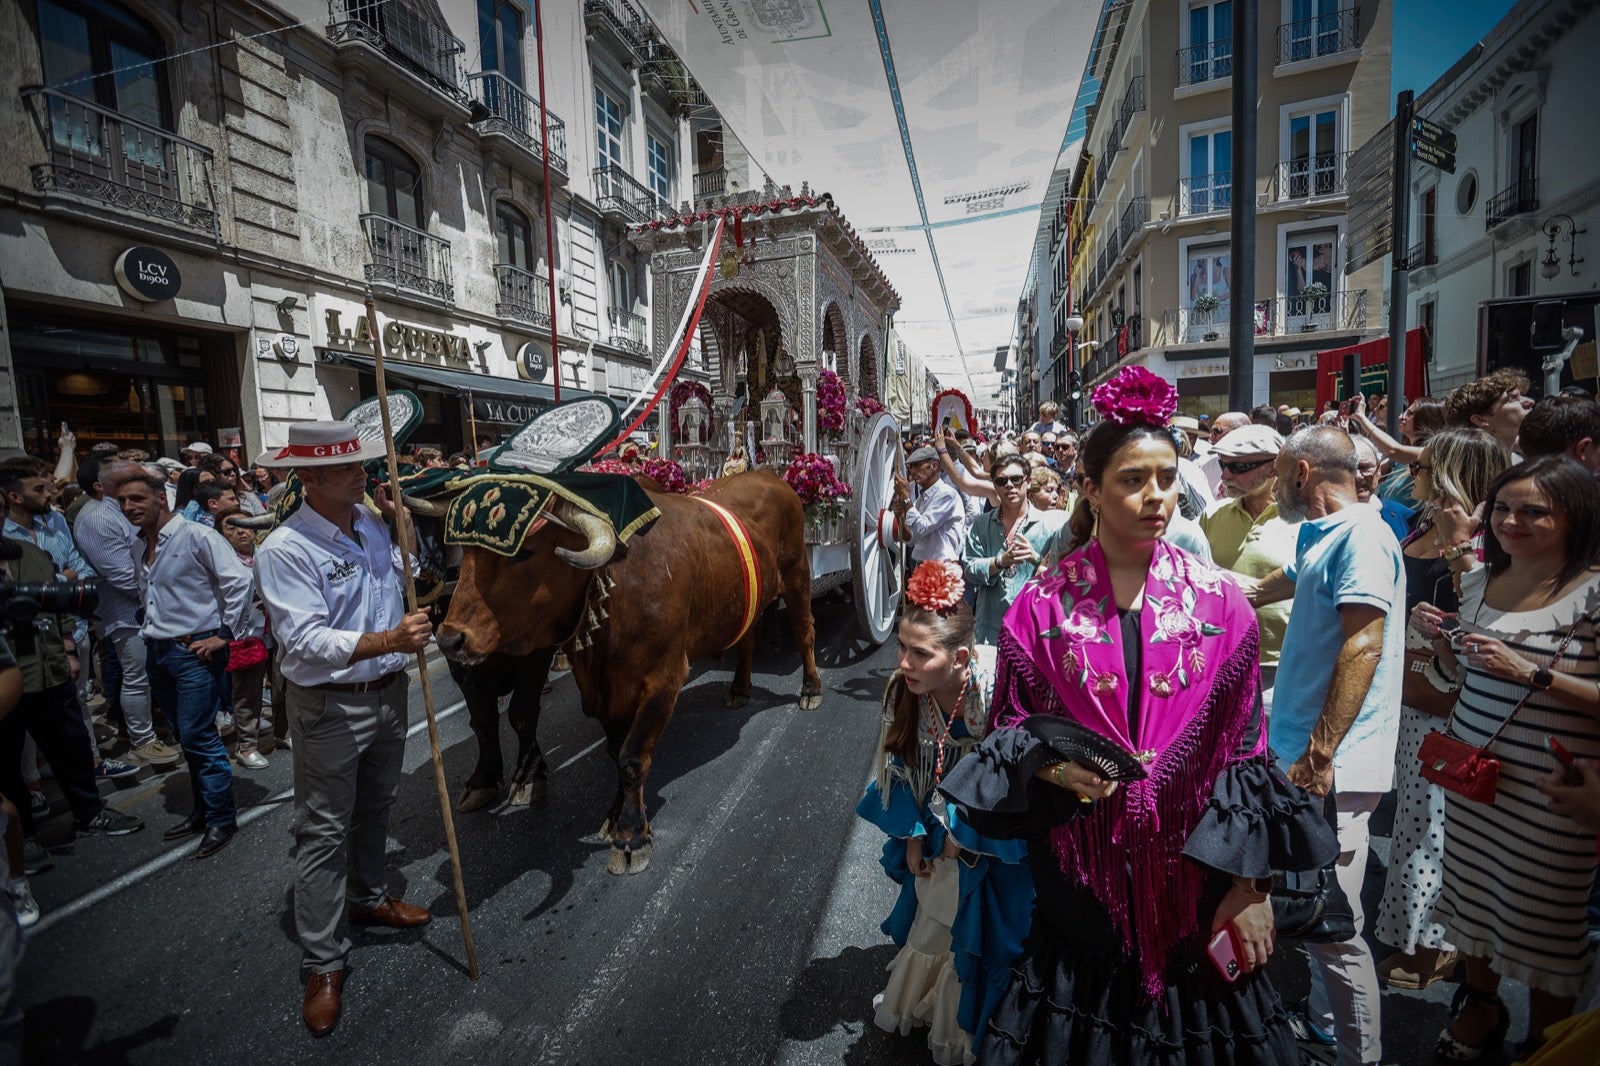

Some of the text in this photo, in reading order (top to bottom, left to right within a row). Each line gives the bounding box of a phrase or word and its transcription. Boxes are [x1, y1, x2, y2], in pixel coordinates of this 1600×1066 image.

[943, 184, 1031, 205] Alhambra
[138, 260, 168, 277] LCV
[325, 308, 474, 361] LA CUEVA
[529, 353, 543, 364] LCV
[1182, 364, 1229, 376] JOYERI
[486, 403, 504, 421] LA
